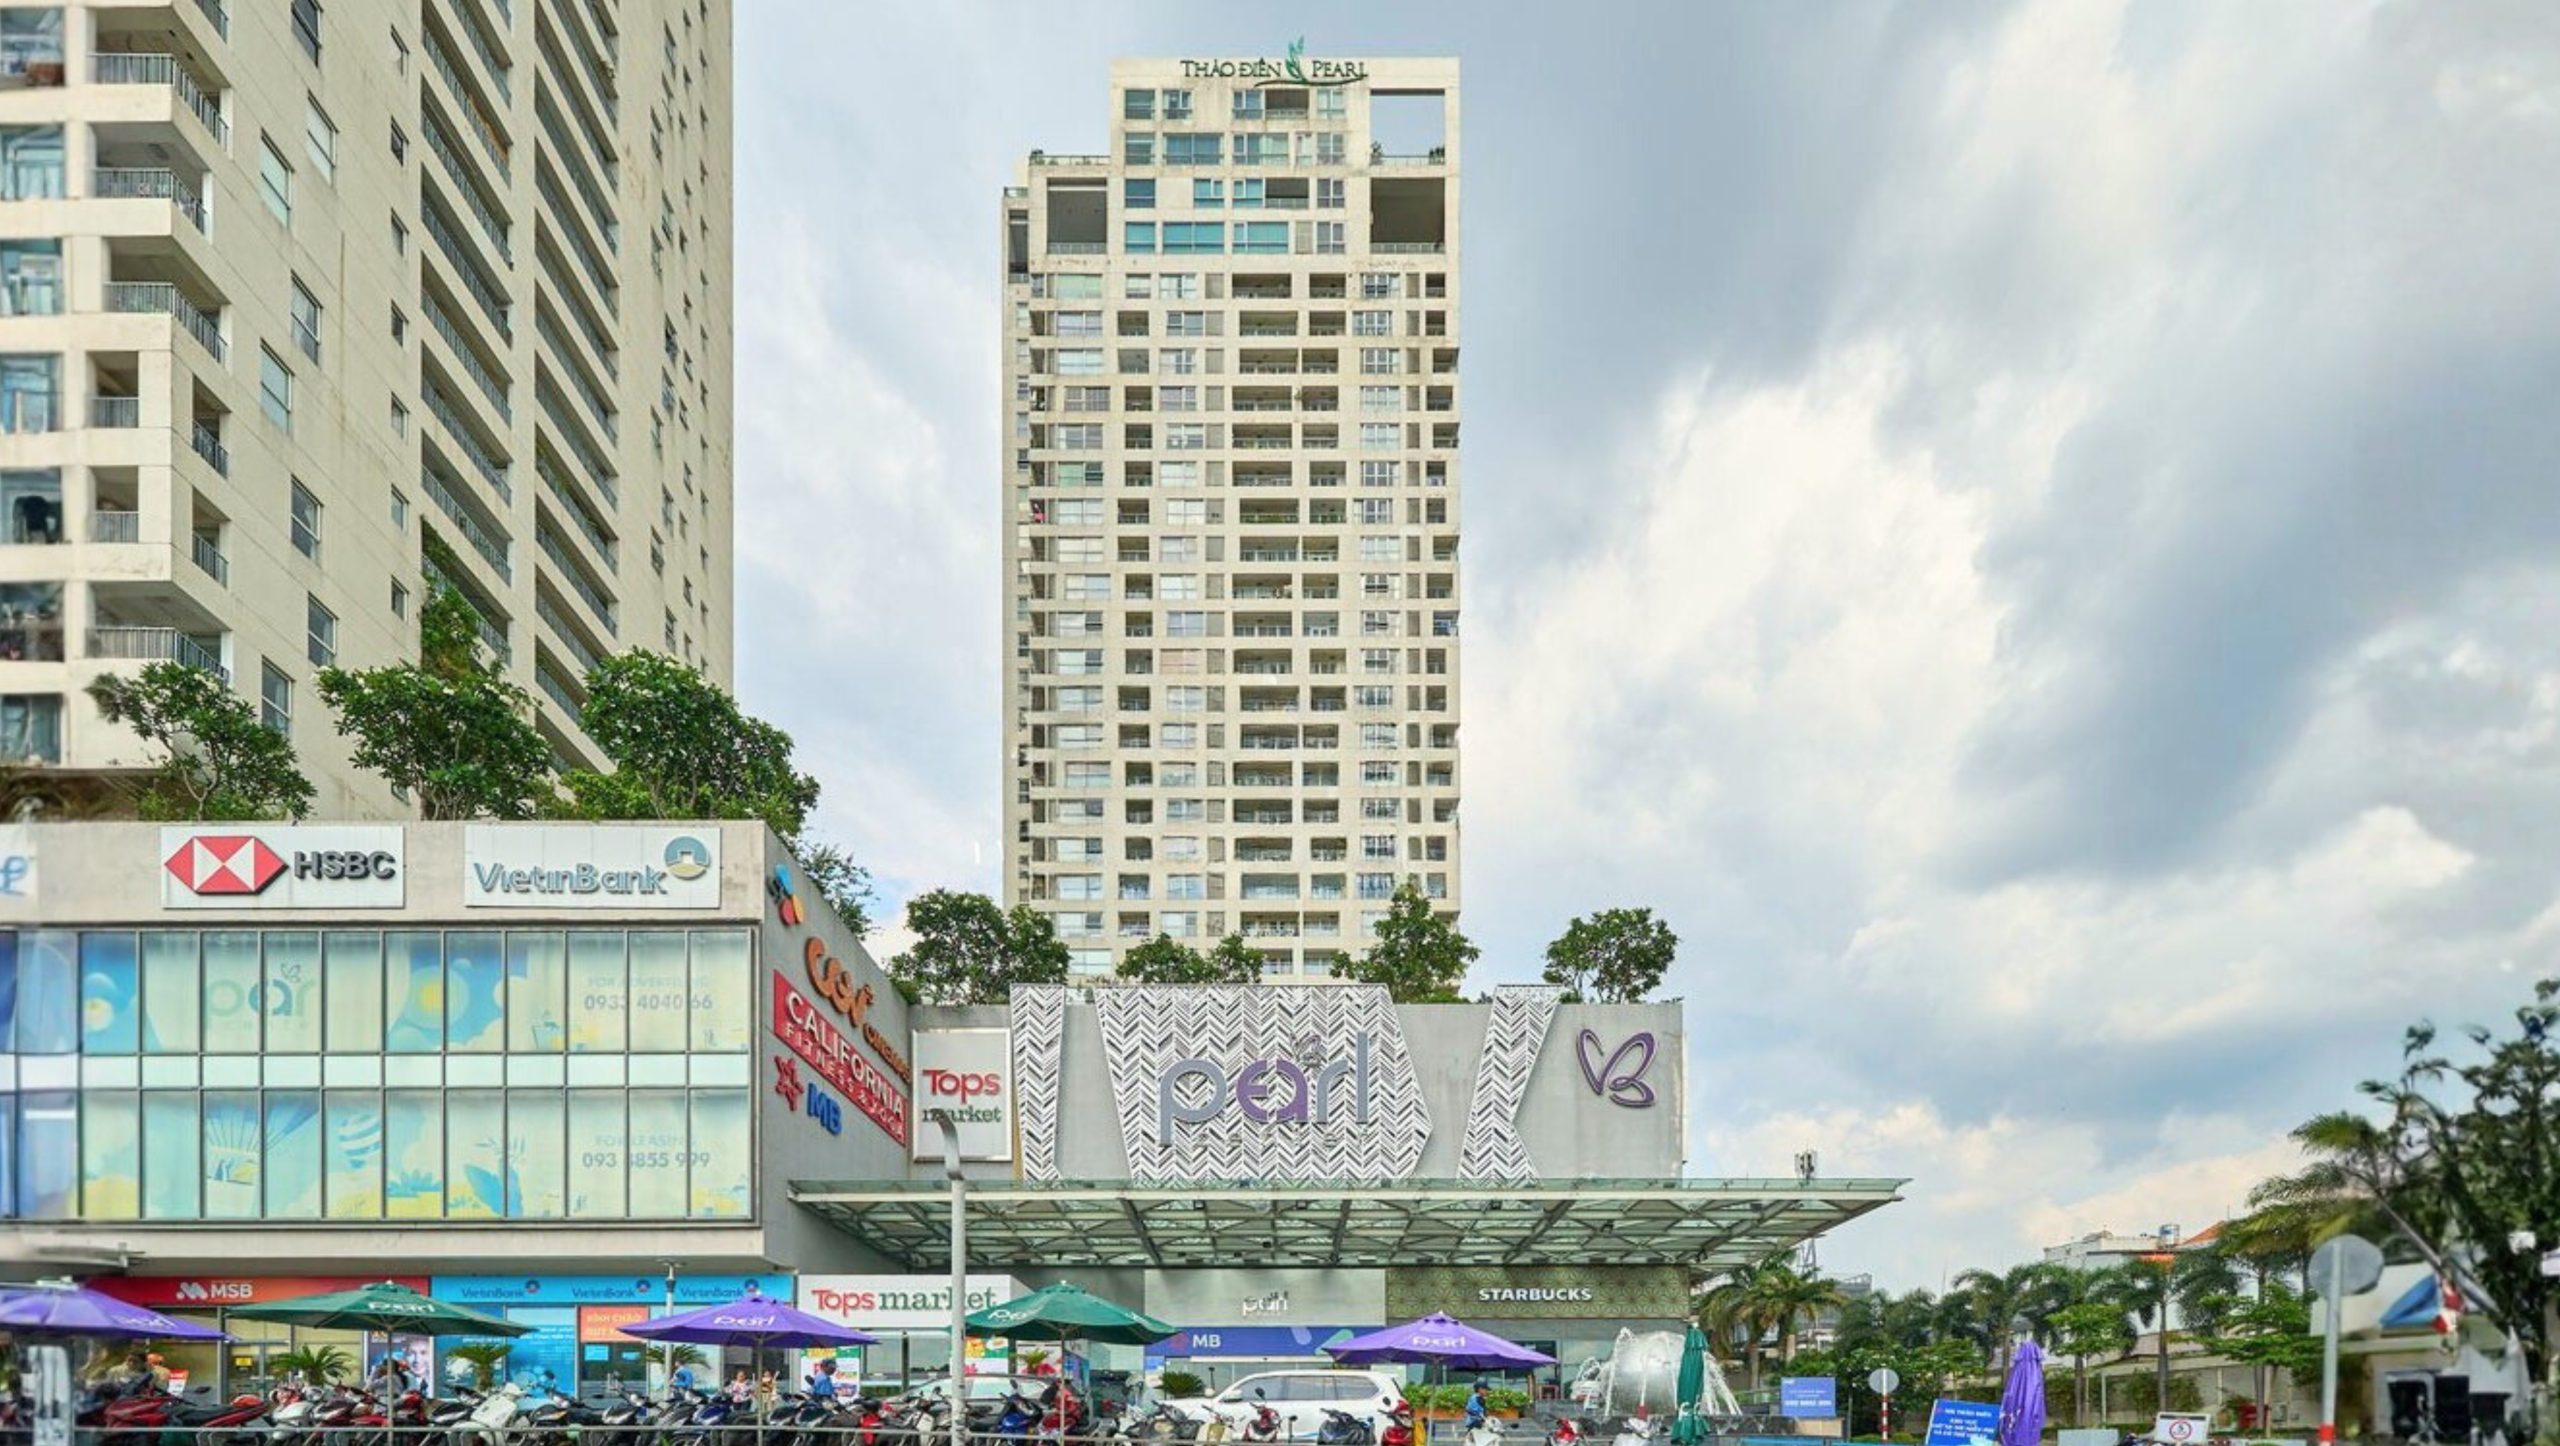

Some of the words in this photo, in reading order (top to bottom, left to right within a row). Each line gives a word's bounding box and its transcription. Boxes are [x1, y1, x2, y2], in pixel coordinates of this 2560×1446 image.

[1312, 60, 1369, 78] PEARL
[294, 850, 398, 881] HSBC
[473, 861, 667, 894] VietinBank
[787, 991, 904, 1123] CALIFORNIA
[922, 1068, 1002, 1104] Tops
[1159, 1032, 1369, 1147] pearl
[807, 1082, 842, 1136] MB
[582, 1151, 617, 1168] 093
[210, 1283, 254, 1299] MSB
[811, 1289, 875, 1318] Tops
[878, 1287, 996, 1311] maret
[1478, 1287, 1593, 1301] STARBUCKS
[1192, 1333, 1222, 1348] MB
